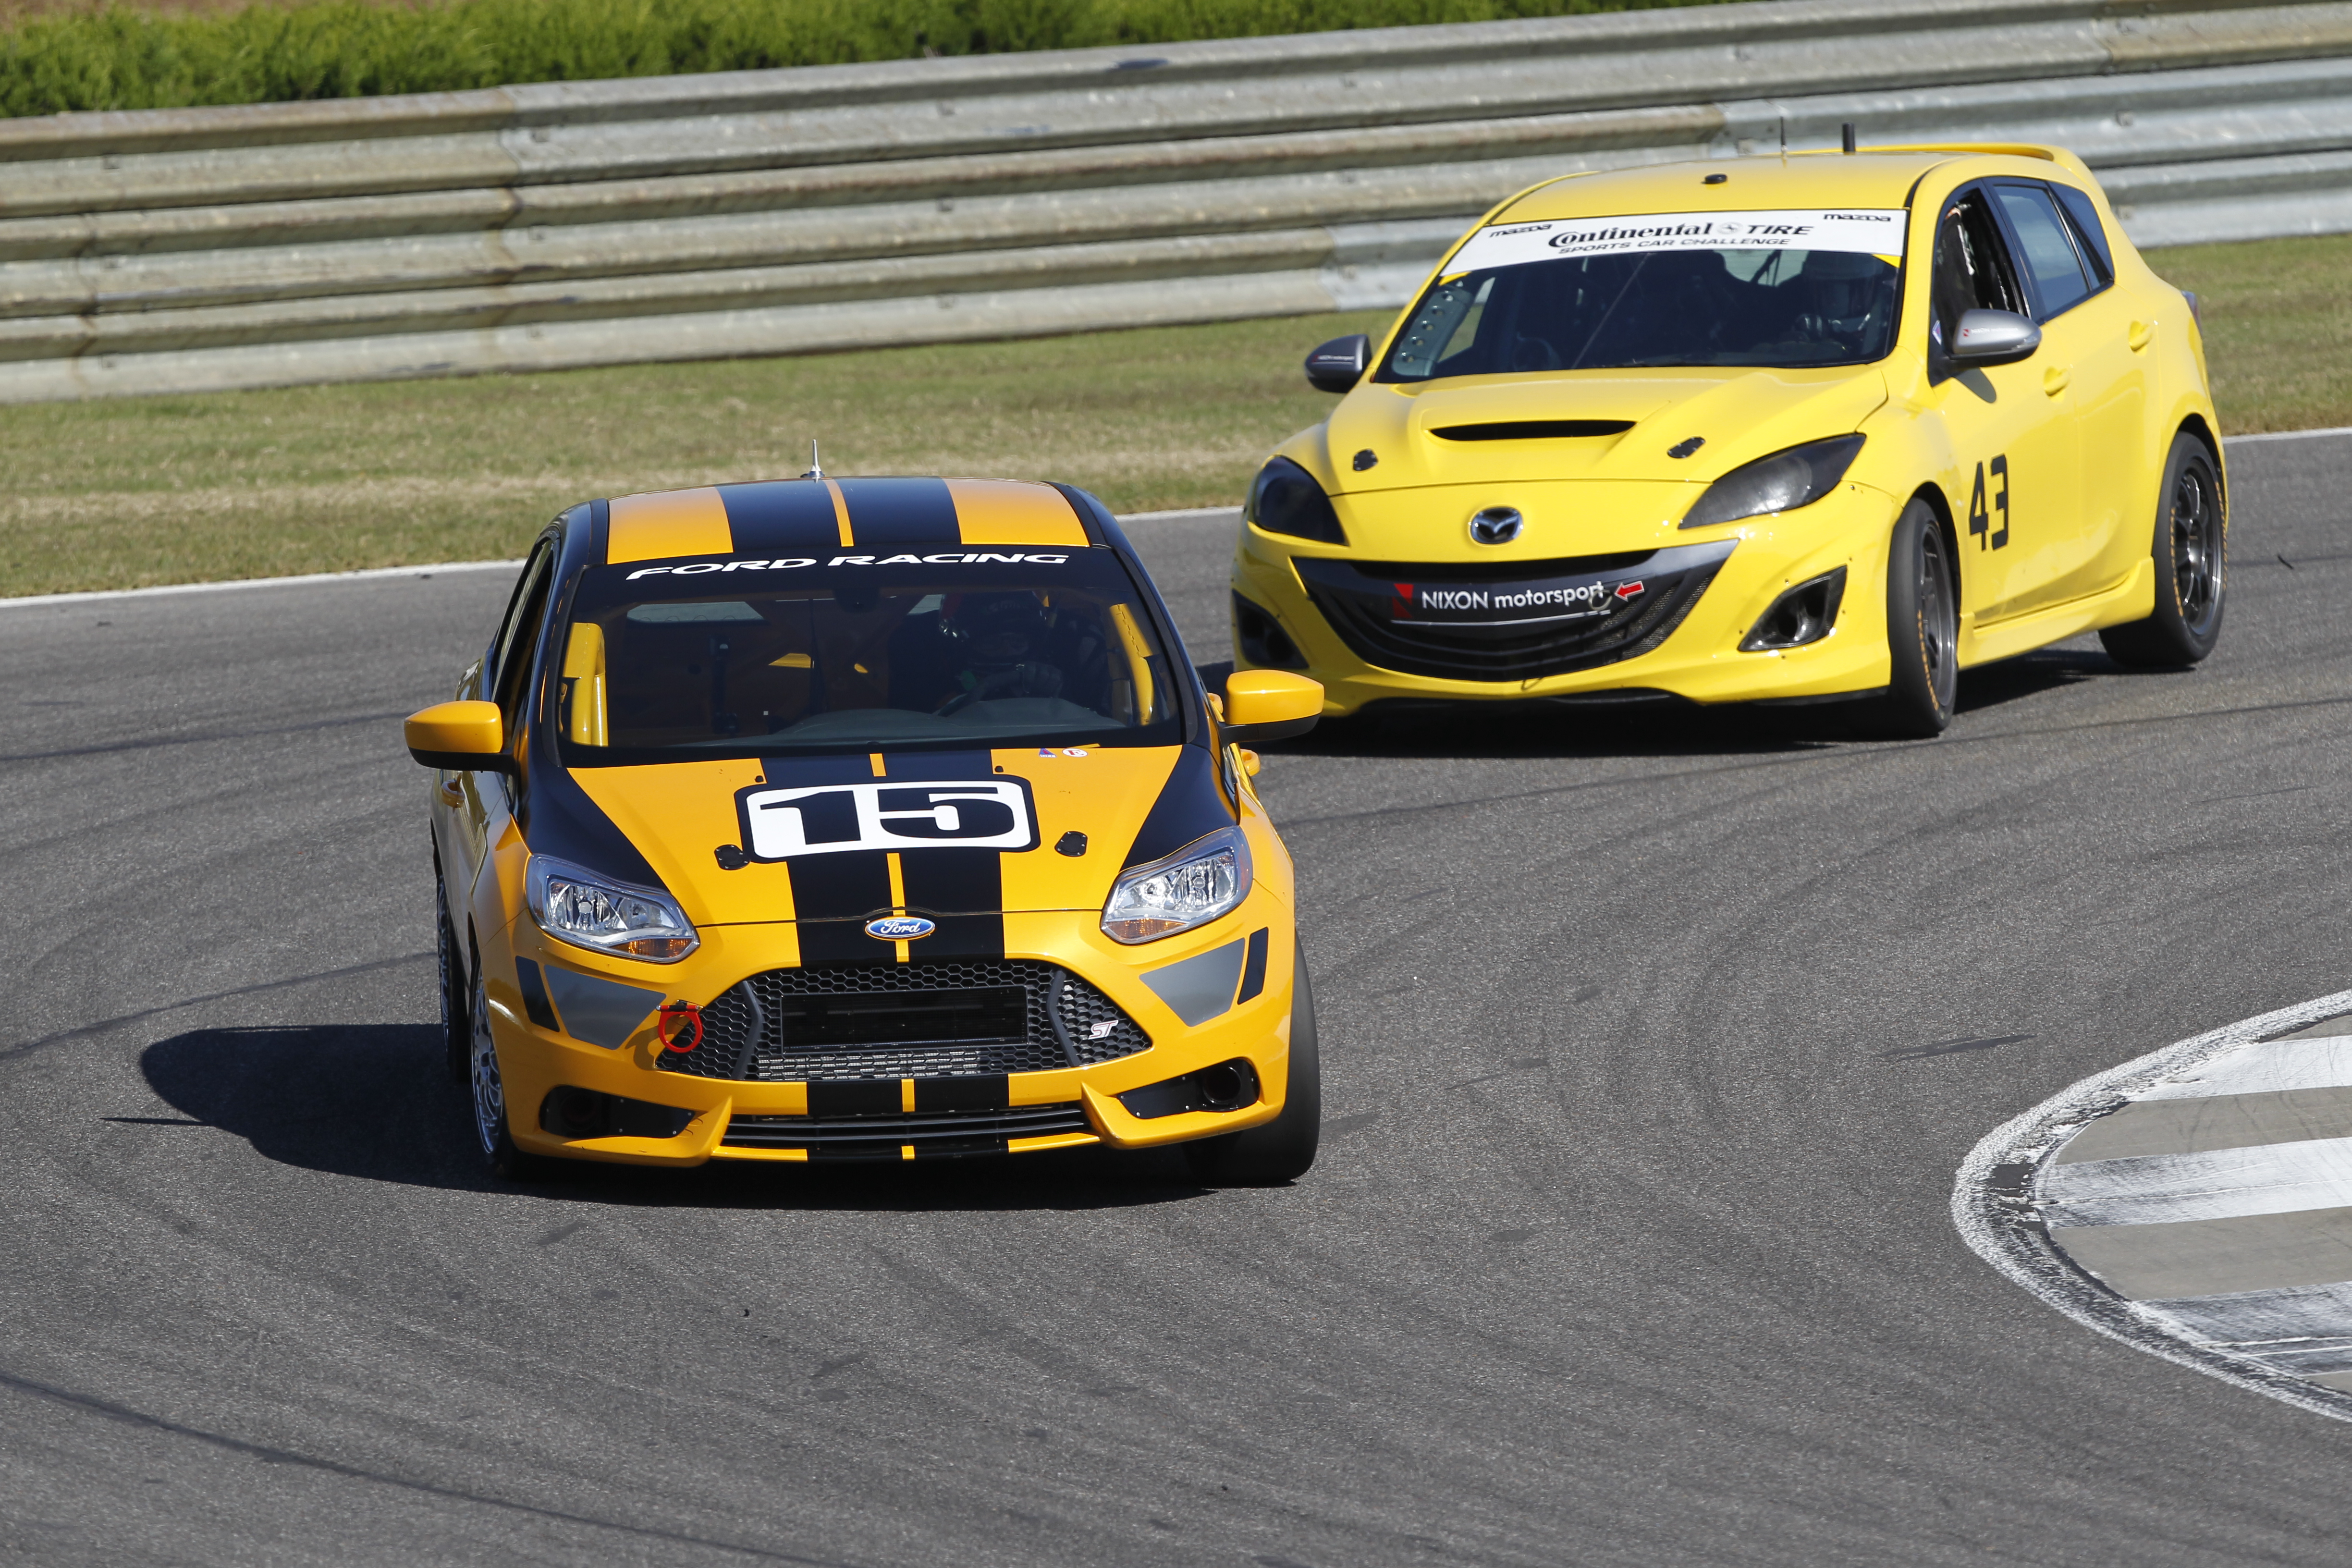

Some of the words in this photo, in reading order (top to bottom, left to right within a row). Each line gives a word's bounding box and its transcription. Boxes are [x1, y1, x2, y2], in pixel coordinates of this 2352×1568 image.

[1824, 214, 1891, 222] mazda
[1548, 222, 1714, 248] Continental
[1747, 224, 1814, 235] TIRE
[1558, 242, 1632, 255] SPORTS
[1637, 239, 1674, 248] CAR
[1969, 453, 2009, 552] 43
[625, 557, 816, 580] FORD
[827, 553, 1069, 567] RACING
[1421, 590, 1489, 610] NIXON
[1494, 580, 1604, 608] motorsport
[760, 786, 1015, 845] 15
[881, 919, 921, 934] Ford
[1088, 1019, 1119, 1040] ST
